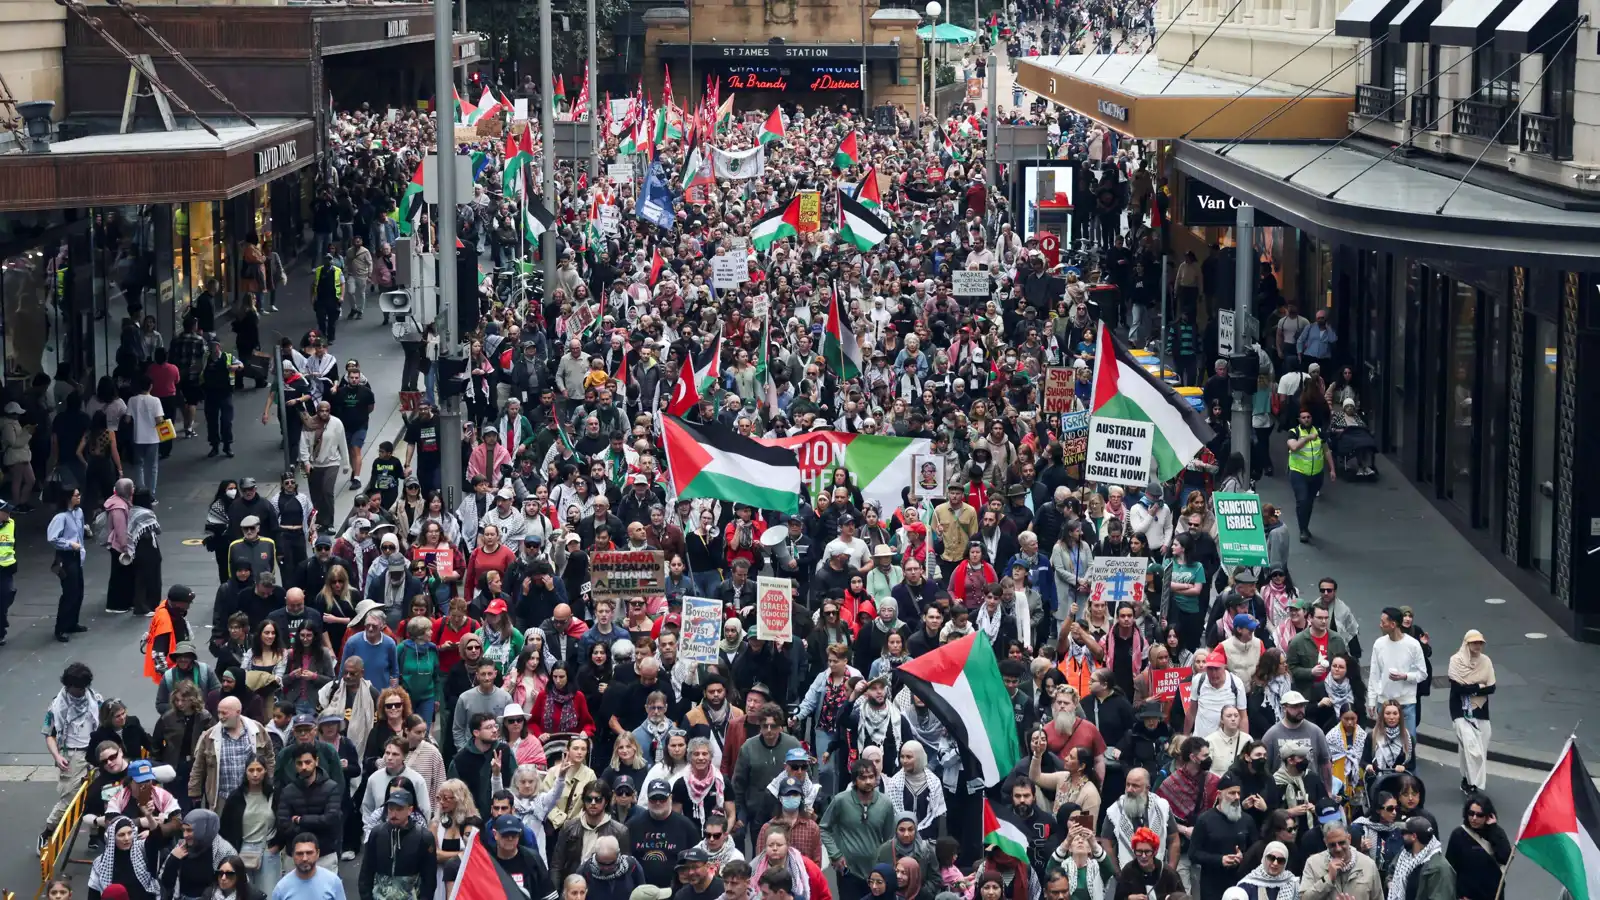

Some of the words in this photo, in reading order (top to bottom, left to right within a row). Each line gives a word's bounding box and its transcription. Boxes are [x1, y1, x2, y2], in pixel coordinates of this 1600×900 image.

[723, 48, 734, 56] ST
[739, 48, 770, 56] JAMES
[785, 48, 828, 56] STATION
[728, 75, 744, 88] The
[746, 73, 787, 91] Brandy
[259, 147, 279, 175] DAVID
[278, 140, 297, 167] JONES
[1197, 195, 1225, 209] Van
[1220, 314, 1233, 327] ONE
[1220, 329, 1233, 341] WAY
[1050, 370, 1073, 380] STOP
[1046, 398, 1071, 412] NOW
[1064, 431, 1076, 441] NO
[1076, 428, 1089, 438] ON
[1096, 423, 1146, 438] AUSTRALIA
[1106, 438, 1133, 451] MUST
[1095, 451, 1142, 466] SANCTION
[1087, 465, 1118, 478] ISRAEL
[1120, 468, 1147, 481] NOW!
[1217, 500, 1259, 514] SANCTION
[1226, 515, 1256, 529] ISRAEL
[592, 563, 613, 571] NEW
[614, 563, 660, 571] ZEALAND
[1105, 559, 1140, 567] GENOCIDE
[607, 571, 653, 579] DEMANDS
[594, 579, 606, 588] A
[607, 579, 638, 588] FREE
[766, 594, 783, 602] STOP
[685, 602, 718, 619] BOYCOTT
[761, 602, 789, 610] ISRAEL'S
[684, 620, 709, 636] DIVEST
[766, 619, 785, 627] NOW!
[682, 638, 717, 655] SANCTION
